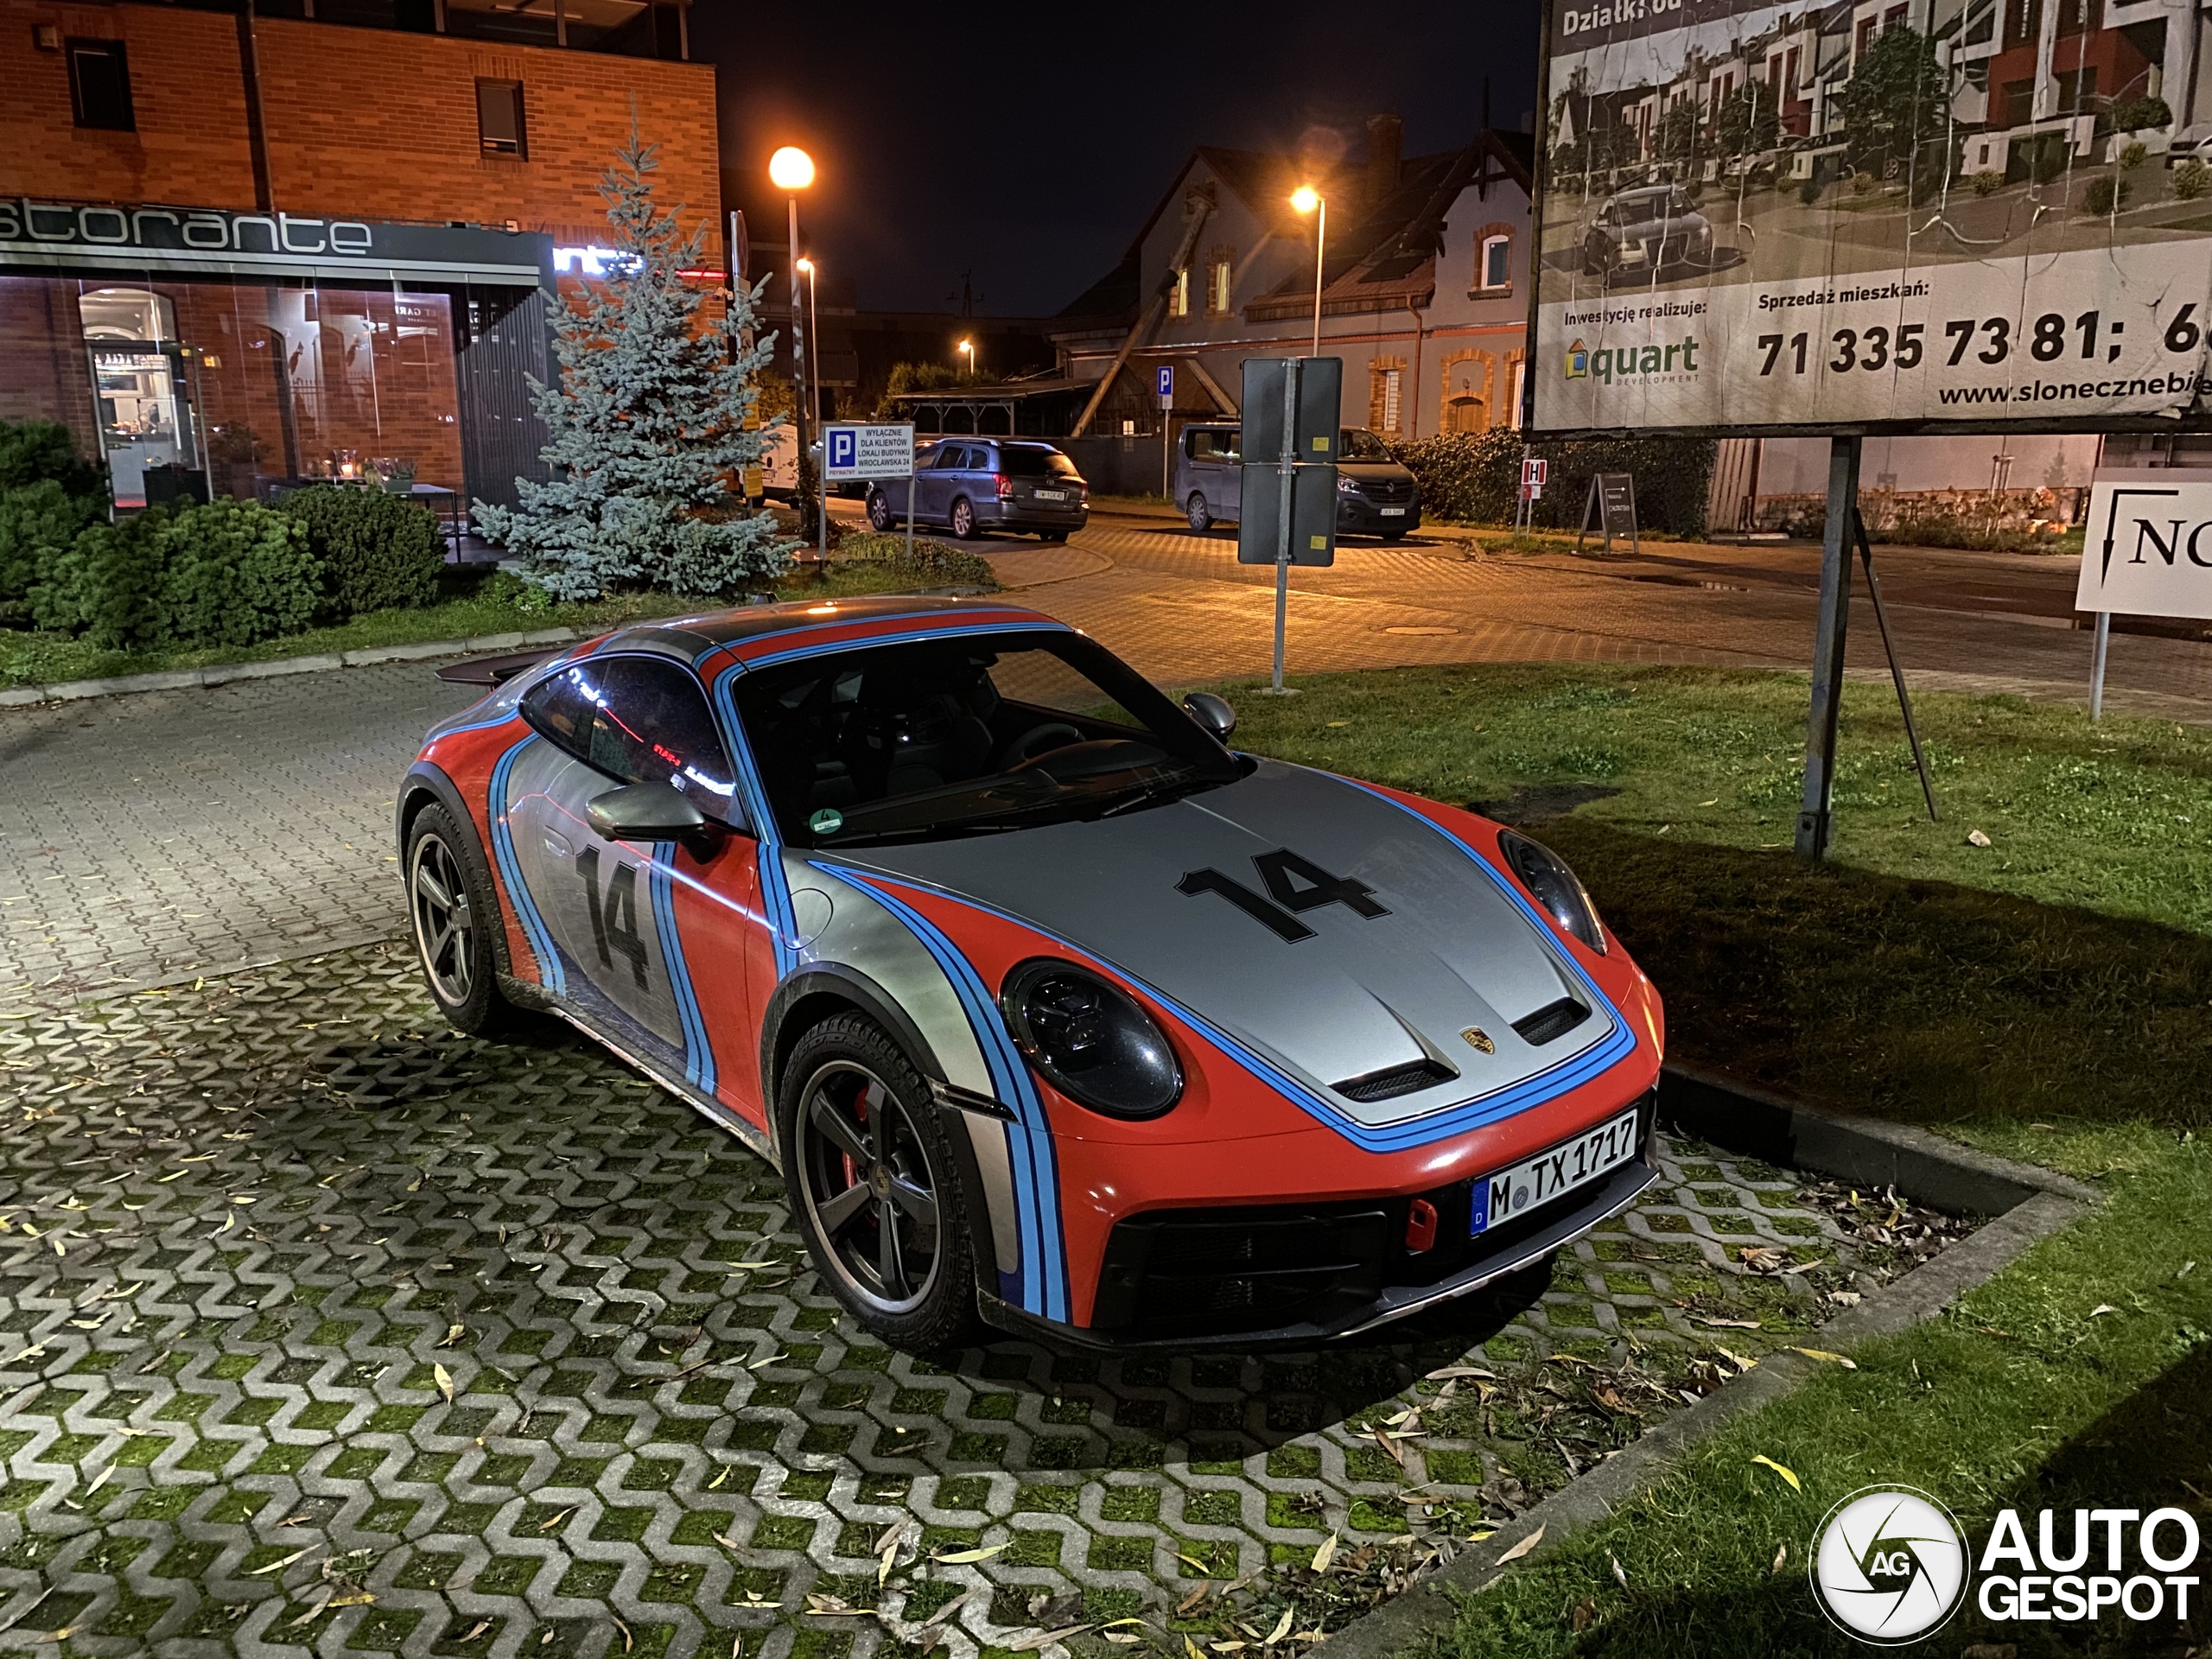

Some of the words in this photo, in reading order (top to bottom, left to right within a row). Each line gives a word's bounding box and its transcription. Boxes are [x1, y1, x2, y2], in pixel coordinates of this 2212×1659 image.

[1759, 288, 1835, 311] Sprzedaż
[1840, 282, 1929, 303] mieszkań:
[1565, 307, 1635, 326] Inwestycję
[1639, 302, 1707, 319] realizuje:
[1758, 333, 1808, 376] 71
[1830, 324, 1924, 372] 335
[1945, 317, 2010, 366] 73
[2031, 311, 2124, 364] 81;
[2164, 303, 2212, 353] 6
[1591, 335, 1699, 385] quart
[1160, 370, 1169, 391] P
[1617, 374, 1700, 385] DEVELOPMENT
[866, 429, 902, 438] WYŁĄCZNIE
[875, 437, 907, 447] KLIENTÓW
[836, 435, 851, 463] P
[858, 459, 901, 467] WROCŁAWSKA
[1529, 463, 1539, 480] H
[821, 810, 830, 821] 4
[1173, 847, 1393, 944] 14
[575, 843, 650, 995] 14
[1490, 1175, 1510, 1221] M
[1531, 1149, 1567, 1200] TX
[1572, 1116, 1634, 1182] 1717
[1475, 1212, 1483, 1224] D
